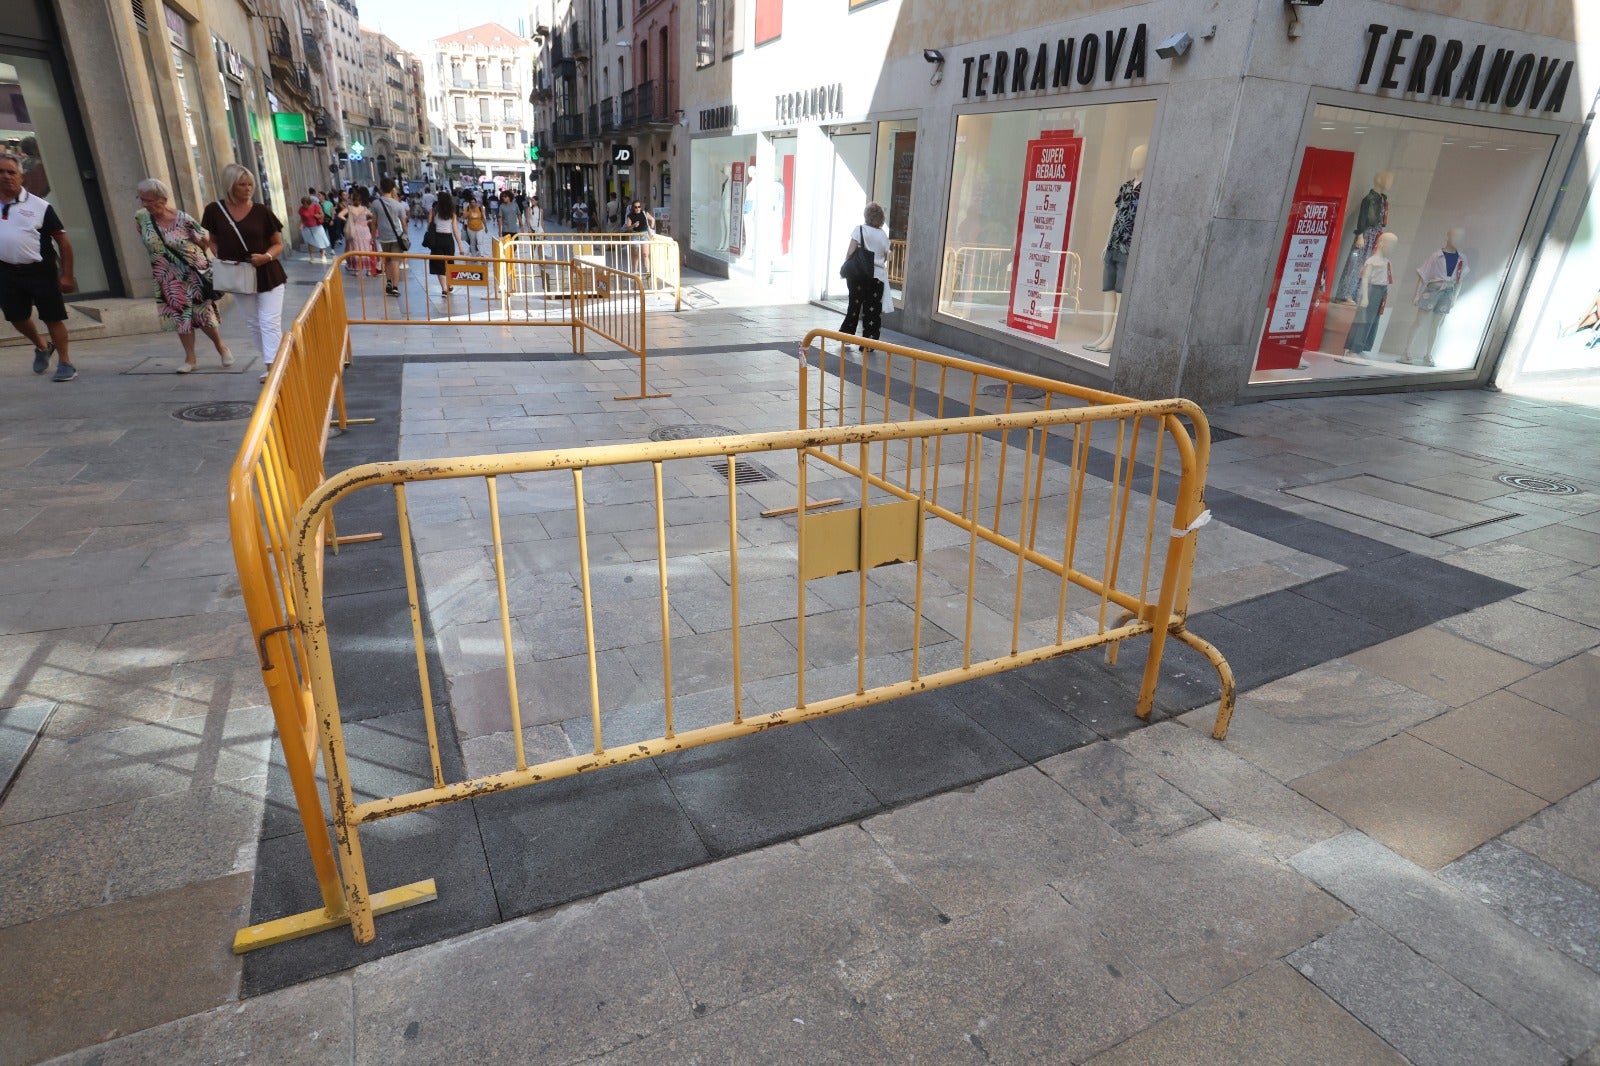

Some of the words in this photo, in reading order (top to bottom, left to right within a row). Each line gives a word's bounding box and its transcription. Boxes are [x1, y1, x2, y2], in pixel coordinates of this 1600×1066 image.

[963, 23, 1147, 98] TERRANOVA
[1358, 23, 1574, 113] TERRANOVA
[775, 83, 844, 122] TERRANOVA
[699, 104, 739, 131] TERRANOVA
[615, 149, 630, 161] JD
[1041, 147, 1065, 164] SUPER
[1035, 164, 1067, 179] REBAJAS
[1303, 204, 1328, 220] SUPER
[1296, 219, 1329, 234] REBAJAS
